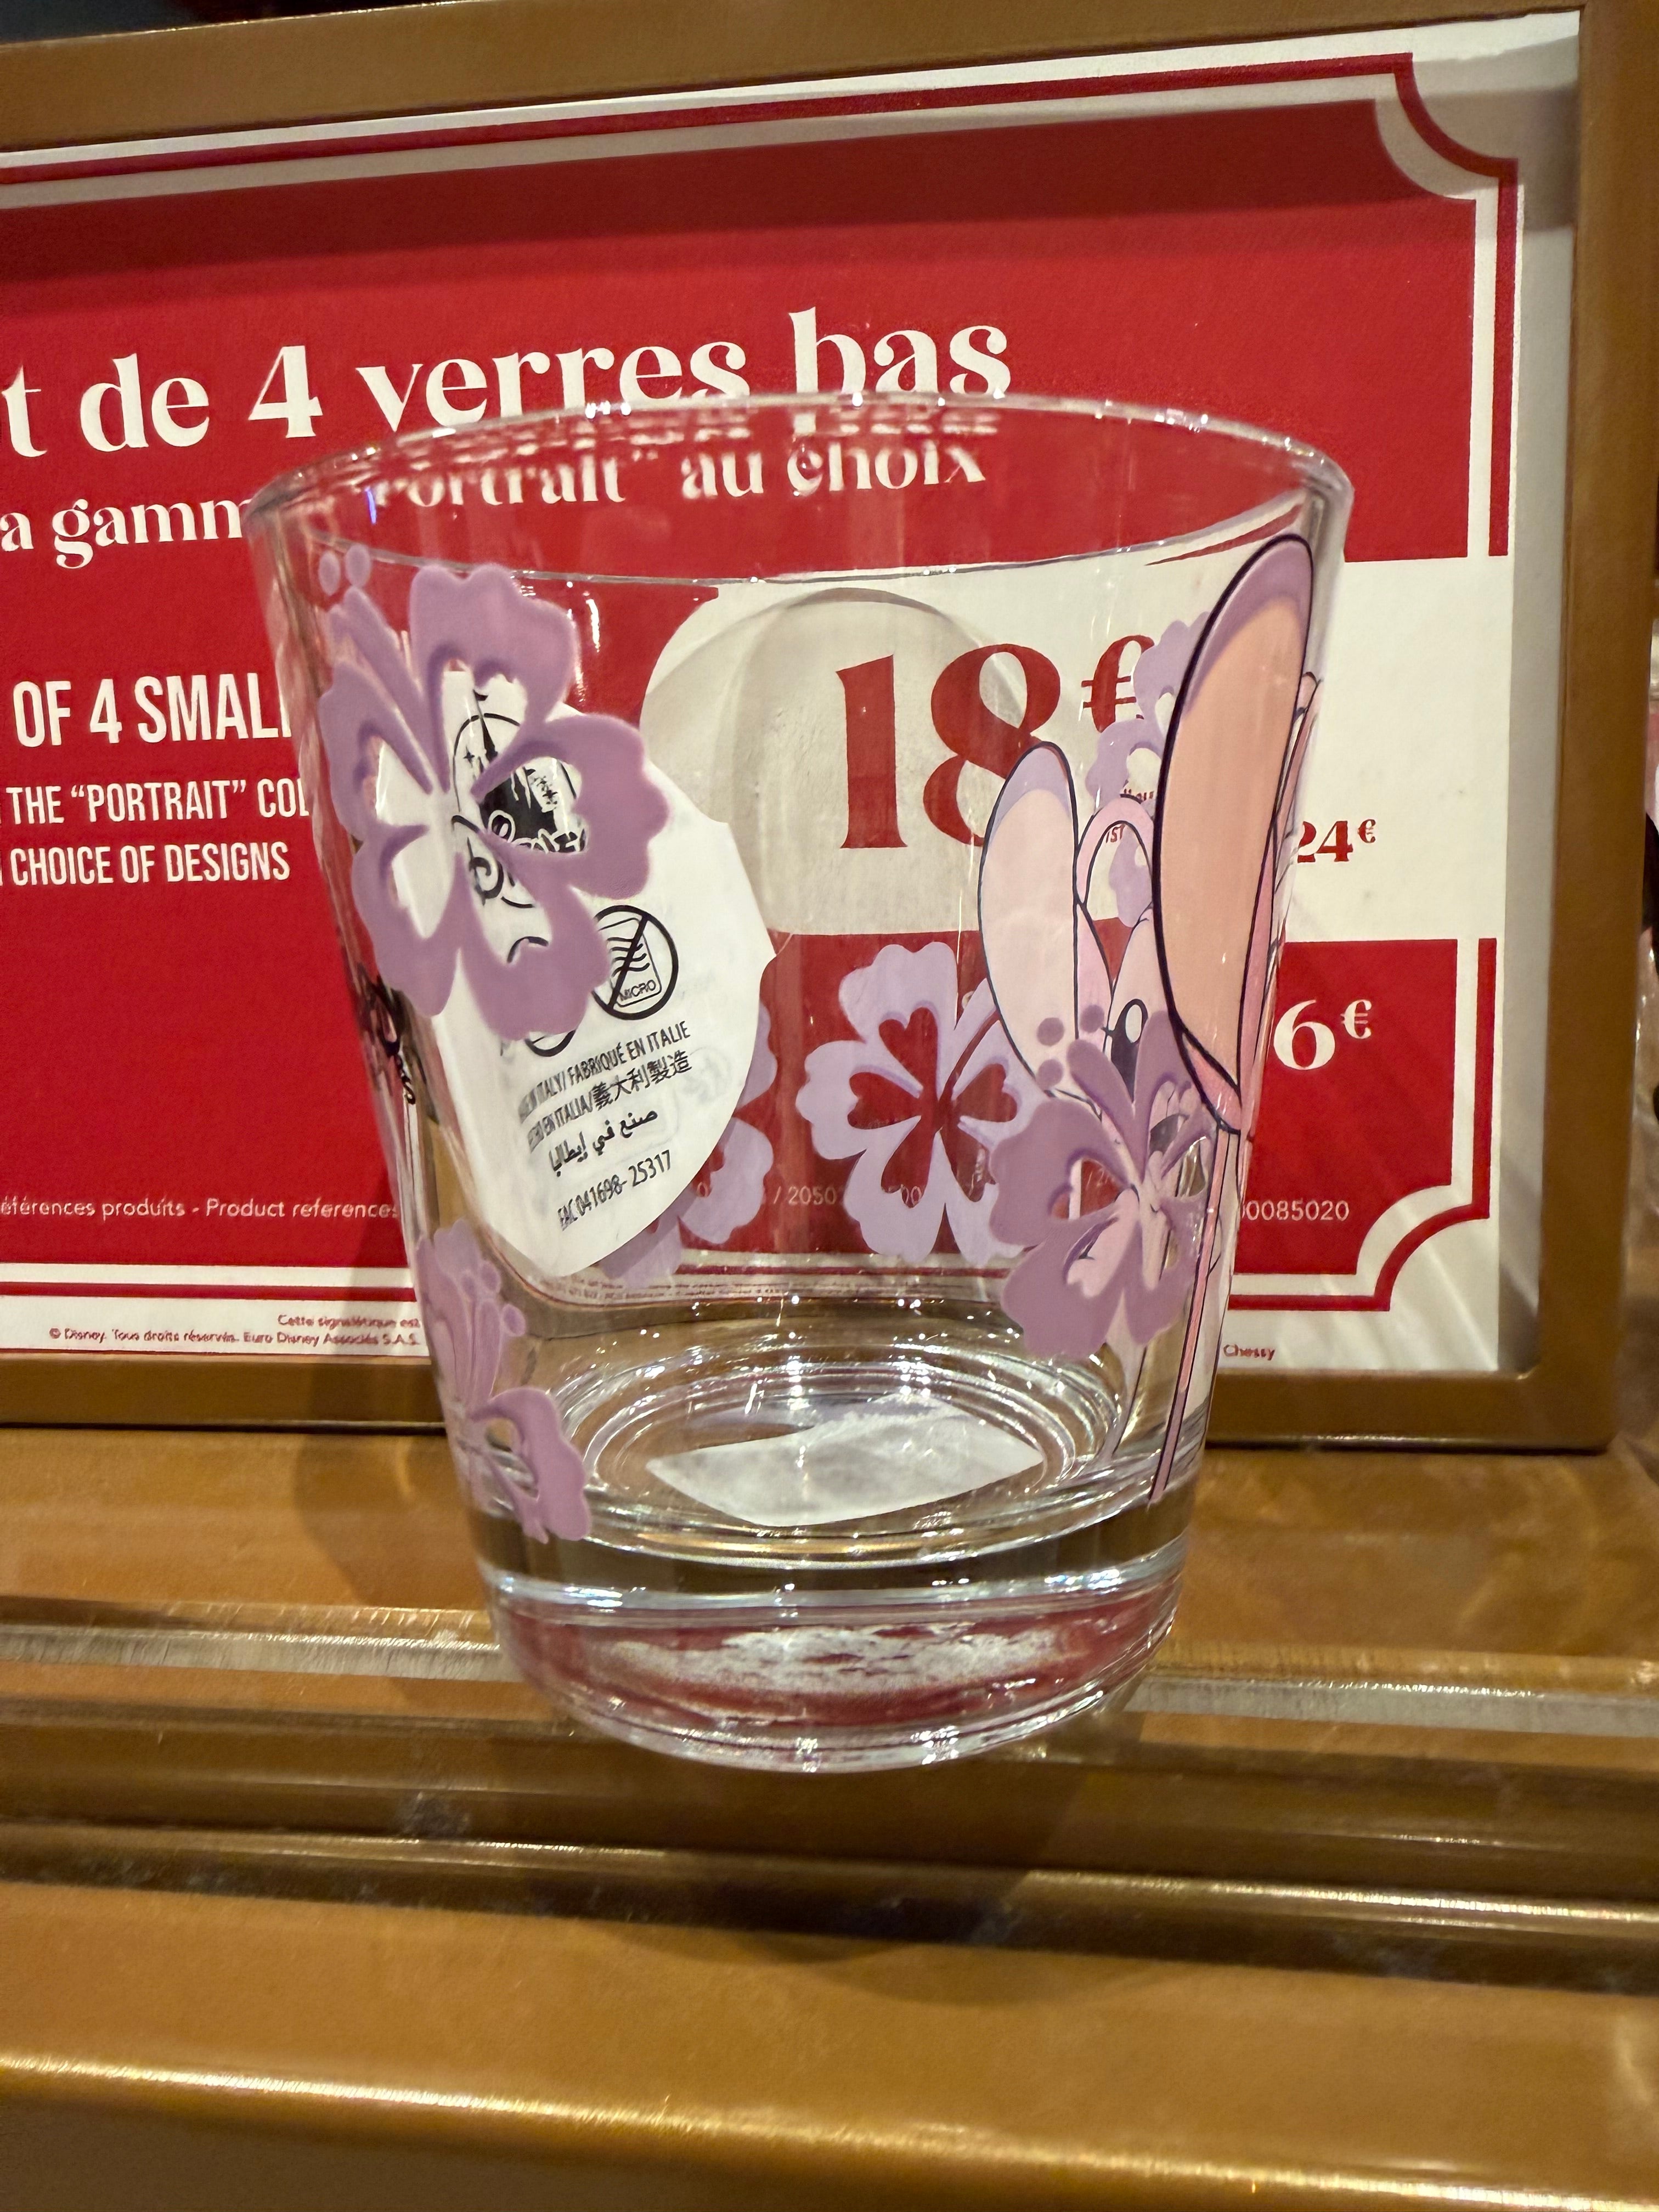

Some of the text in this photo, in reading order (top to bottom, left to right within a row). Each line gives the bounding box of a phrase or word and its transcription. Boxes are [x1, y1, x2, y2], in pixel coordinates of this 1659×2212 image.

[80, 352, 210, 453] de
[248, 345, 323, 439] 4
[356, 340, 751, 432] verres
[788, 306, 1011, 398] bas
[680, 451, 764, 500] au
[786, 440, 986, 497] choix
[52, 498, 252, 569] gamm
[12, 680, 72, 747] OF
[89, 678, 122, 744] 4
[5, 786, 65, 825] THE
[10, 842, 291, 886] CHOICE OF DESIGNS
[625, 1037, 647, 1061] EN
[646, 1020, 691, 1053] ITALIE
[1273, 998, 1372, 1071] 6€
[592, 1119, 616, 1156] في
[620, 1110, 659, 1139] صنع
[101, 1194, 186, 1222] produits
[206, 1196, 286, 1218] Product
[1241, 1199, 1350, 1221] 0085020
